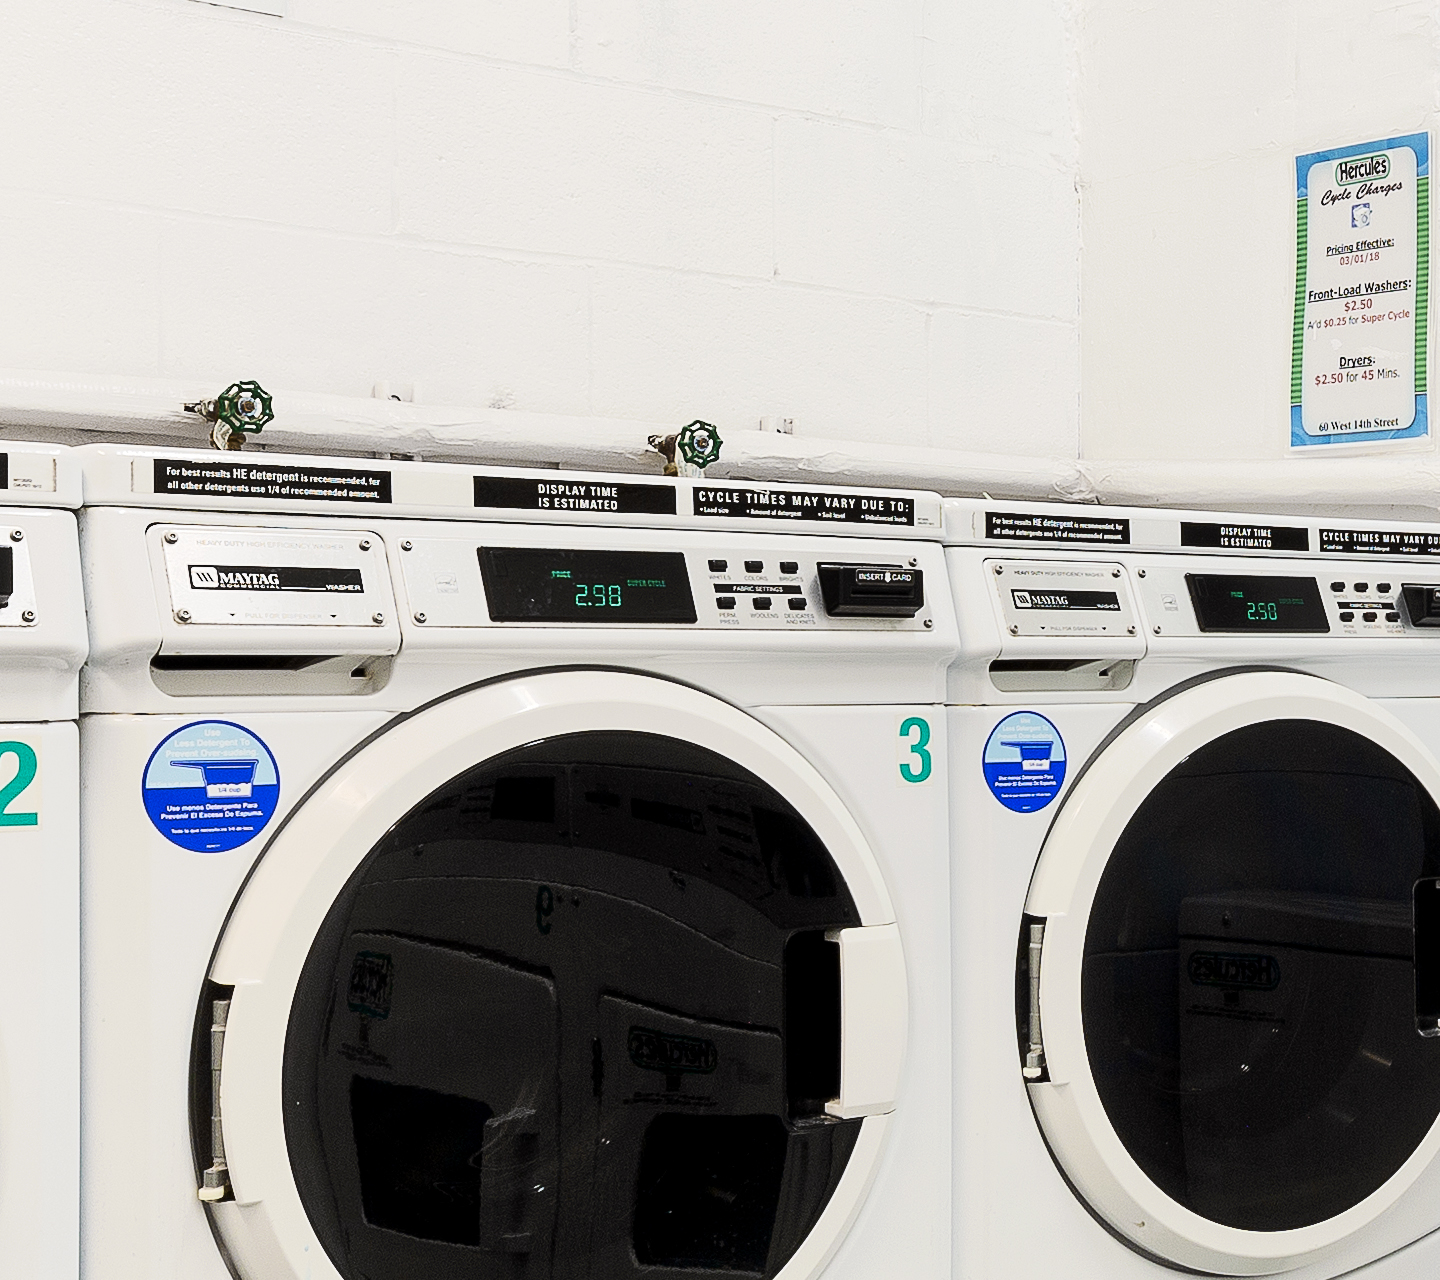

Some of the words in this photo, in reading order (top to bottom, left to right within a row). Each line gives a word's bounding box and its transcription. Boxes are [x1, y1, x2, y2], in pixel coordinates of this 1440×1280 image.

[1339, 157, 1387, 183] Hercules
[1321, 189, 1353, 206] Cycle
[1356, 182, 1403, 201] Charges
[1326, 243, 1353, 256] Pricing
[1356, 237, 1394, 252] Effective:
[1339, 251, 1380, 266] 03/01/18
[1308, 284, 1361, 302] Front-Load
[1364, 279, 1412, 293] Washers:
[1344, 298, 1373, 313] $2.50
[1324, 317, 1346, 327] $0.25
[1349, 315, 1359, 324] for
[1361, 314, 1385, 324] Super
[1388, 310, 1410, 321] Cycle
[1339, 356, 1376, 370] Dryers:
[1315, 372, 1344, 386] $2.50
[1346, 371, 1358, 382] for
[1361, 369, 1374, 381] 45
[1377, 367, 1400, 380] Mins.
[1319, 422, 1329, 432] 60
[1331, 420, 1352, 431] West
[1354, 418, 1372, 429] 14th
[1373, 417, 1399, 428] Street
[537, 483, 585, 497] DISPLAY
[590, 486, 618, 498] TIME
[538, 497, 551, 509] IS
[554, 498, 618, 511] ESTIMATED
[698, 490, 740, 504] CYCLE
[746, 493, 786, 506] TIMES
[792, 495, 819, 508] MAY
[824, 497, 856, 510] VARY
[861, 499, 885, 511] DUE
[889, 500, 909, 512] TO:
[1220, 527, 1252, 537] DISPLAY
[1253, 528, 1272, 538] TIME
[1221, 538, 1229, 546] IS
[1231, 538, 1272, 548] ESTIMATED
[219, 572, 279, 586] MAYTAG
[575, 584, 622, 607] 2.98
[1031, 595, 1068, 605] MAYTAG
[1247, 602, 1277, 620] 2.50
[898, 717, 932, 783] 3
